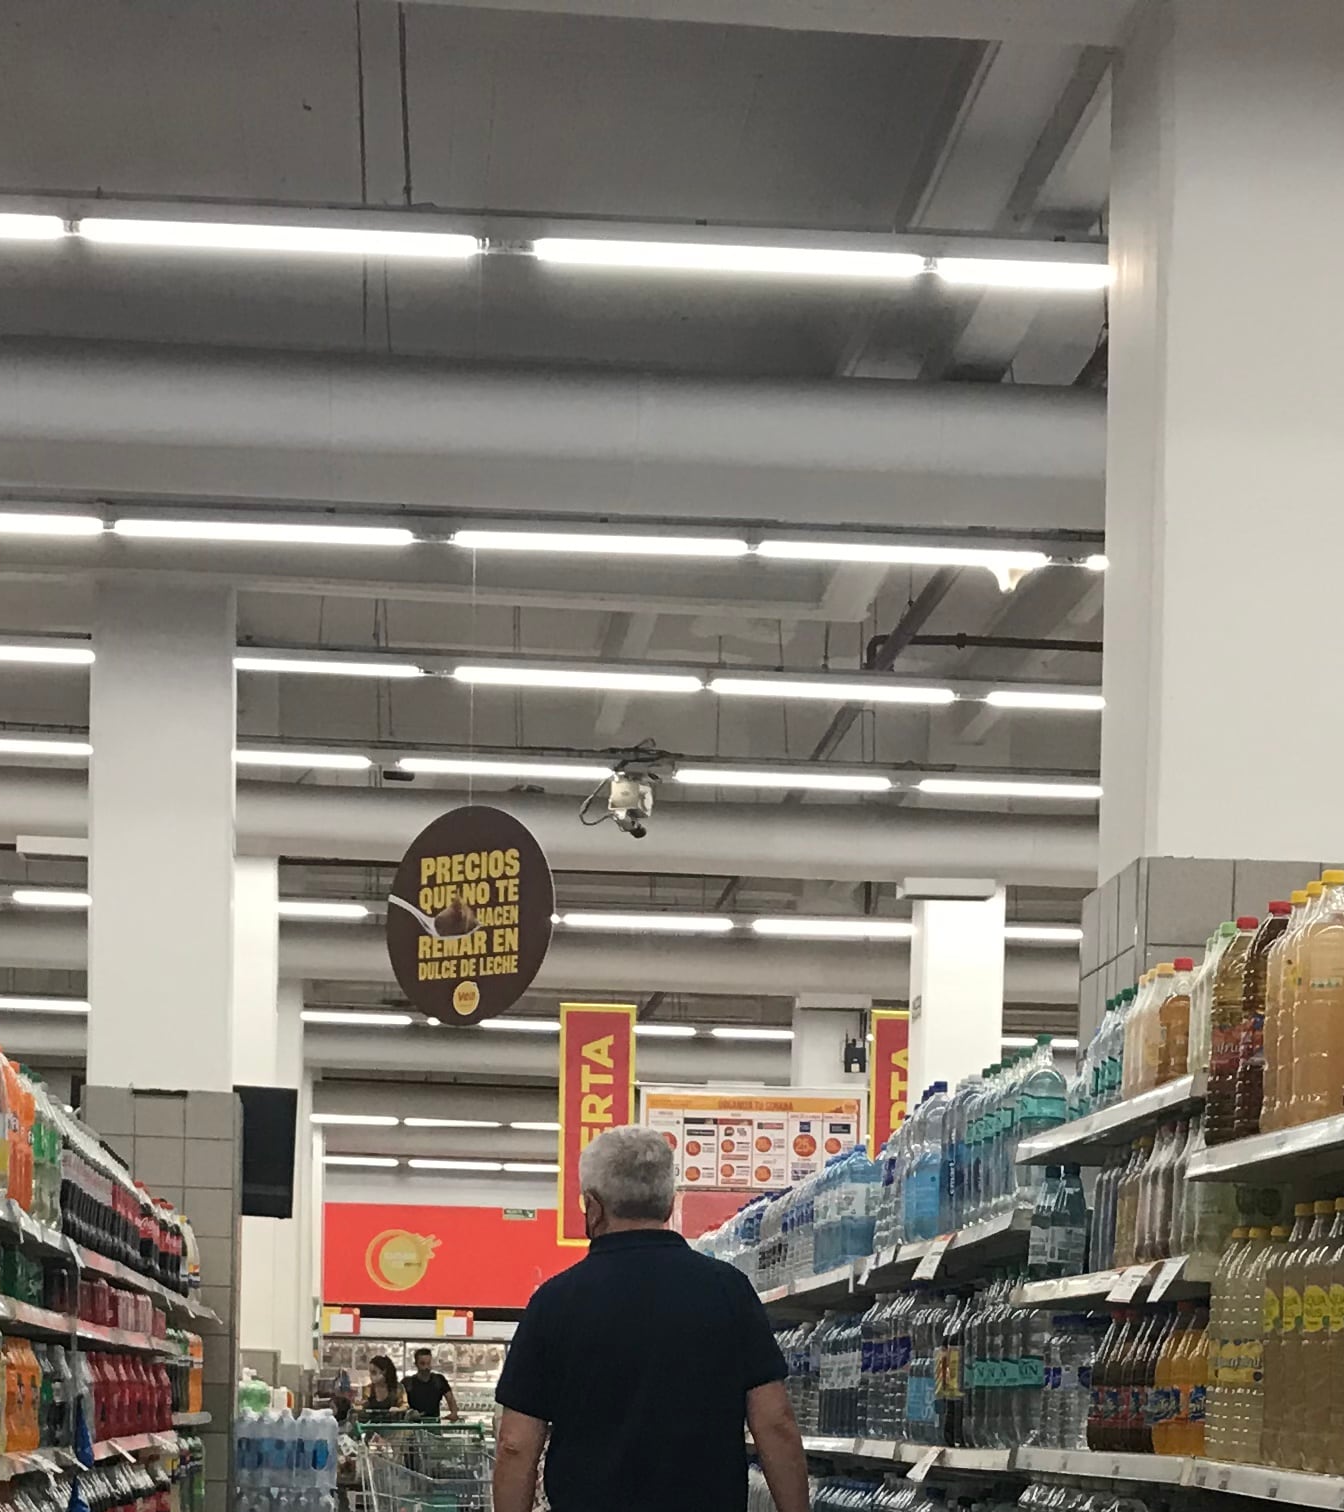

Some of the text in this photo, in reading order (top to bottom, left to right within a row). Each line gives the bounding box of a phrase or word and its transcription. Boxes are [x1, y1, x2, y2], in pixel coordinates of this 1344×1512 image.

[420, 848, 520, 885] PRECIOS
[419, 879, 519, 914] QUE NO TE
[476, 905, 519, 926] HACEN
[418, 928, 519, 958] REMAR EN
[418, 955, 518, 980] DULCE DE LECHE
